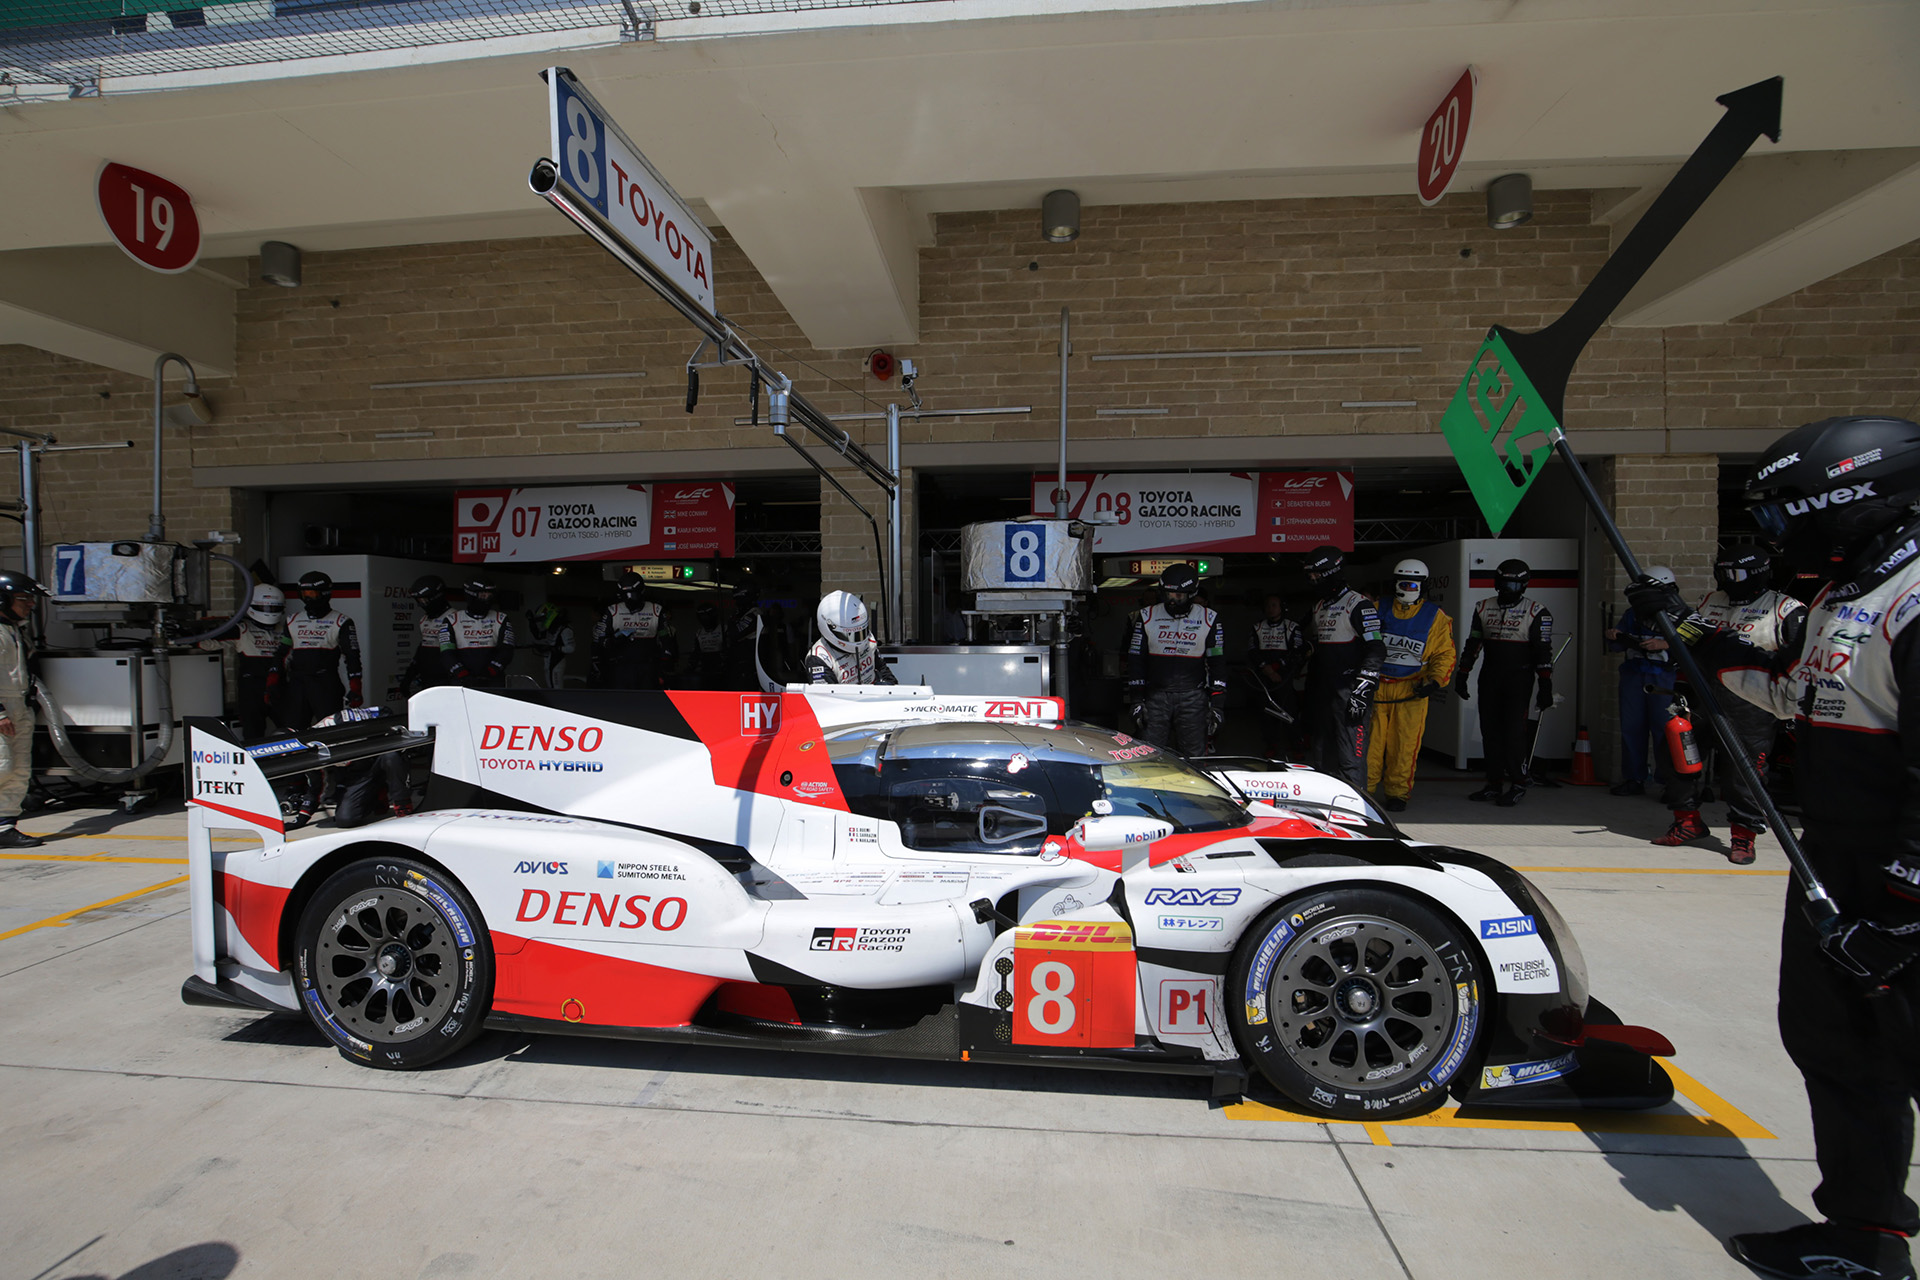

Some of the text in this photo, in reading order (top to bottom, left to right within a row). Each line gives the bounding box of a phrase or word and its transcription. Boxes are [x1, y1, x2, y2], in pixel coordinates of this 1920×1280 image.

[566, 95, 600, 199] 8
[1428, 96, 1459, 186] 20
[130, 183, 174, 251] 19
[610, 158, 709, 290] TOYOTA
[1757, 452, 1802, 480] uvex
[1828, 462, 1855, 478] GR
[1283, 477, 1328, 489] WEC
[674, 488, 714, 500] WEC
[1138, 491, 1193, 504] TOYOTA
[1785, 481, 1878, 517] uvex
[548, 503, 596, 517] TOYOTA
[1138, 505, 1242, 518] GAZOO RACING
[511, 506, 542, 538] 07
[547, 514, 638, 530] GAZOO RACING
[1138, 520, 1172, 529] TOYOTA
[1173, 520, 1198, 528] TS050
[1204, 519, 1236, 528] HYBRID
[548, 532, 577, 540] TOYOTA
[577, 531, 600, 539] TS050
[604, 529, 633, 538] HYBRID
[460, 536, 499, 551] P1 HY
[1009, 529, 1041, 578] 8
[58, 550, 81, 592] 7
[674, 567, 684, 579] 7
[1131, 561, 1140, 574] 8
[1428, 575, 1450, 589] ENSO
[1486, 618, 1521, 628] DENSO
[297, 629, 327, 637] DENSO
[1157, 630, 1198, 641] DENSO
[1389, 637, 1423, 654] LANE
[743, 702, 779, 729] HY
[904, 704, 979, 715] SYNCROMATIC
[984, 701, 1048, 719] ZENT
[480, 725, 604, 753] DENSO
[193, 750, 245, 765] Mobil 1
[1108, 744, 1158, 761] TOYOTA
[479, 758, 604, 773] TOYOTA HYBRID
[196, 780, 245, 797] JTEKT
[1244, 779, 1302, 797] TOYOTA 8
[1244, 789, 1290, 799] HYBRID
[1124, 831, 1157, 844] Mobil
[514, 860, 569, 875] ADVICS
[617, 869, 687, 881] SUMITOMO METAL
[618, 862, 679, 873] NIPPON STEEL &
[1145, 887, 1242, 906] RAYS
[429, 890, 470, 944] MICHELIN
[515, 887, 689, 932] DENSO
[1163, 918, 1221, 929] 林テレンプ
[1485, 918, 1533, 937] AISIN
[861, 928, 912, 936] TOYOTA
[1030, 923, 1118, 943] DHL
[1319, 926, 1358, 946] RAYS
[811, 936, 855, 951] GR
[859, 936, 907, 944] GAZOO
[857, 943, 904, 953] Racing
[1252, 924, 1287, 993] MICHELIN
[1500, 959, 1545, 973] MITSUBISHI
[1512, 967, 1556, 982] ELECTRIC
[1027, 960, 1077, 1036] 8
[1168, 989, 1207, 1026] P1
[1436, 1016, 1470, 1083] MICHELIN
[1515, 1050, 1575, 1078] MICHELIN
